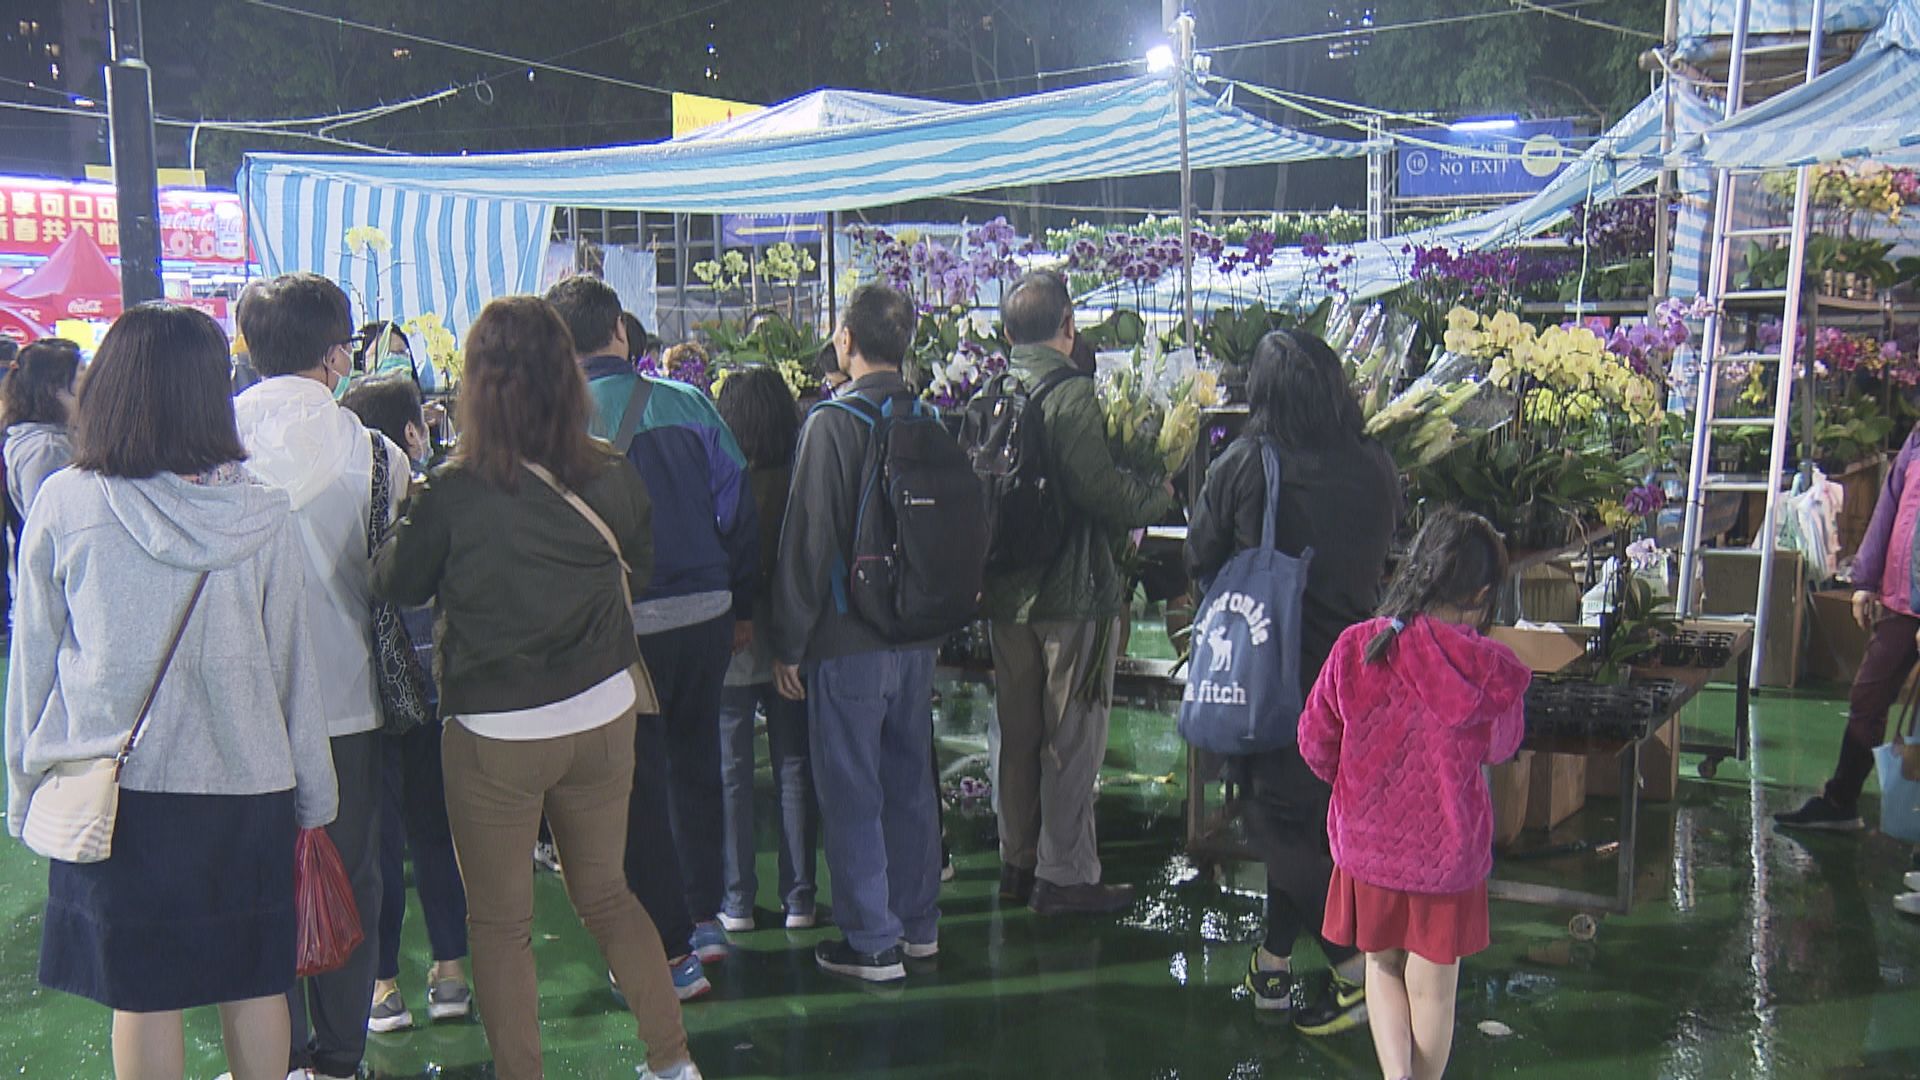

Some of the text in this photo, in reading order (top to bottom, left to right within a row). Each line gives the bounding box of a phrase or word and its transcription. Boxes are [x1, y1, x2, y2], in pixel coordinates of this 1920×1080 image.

[1440, 159, 1508, 176] NO EXIT
[1198, 680, 1247, 704] fitch
